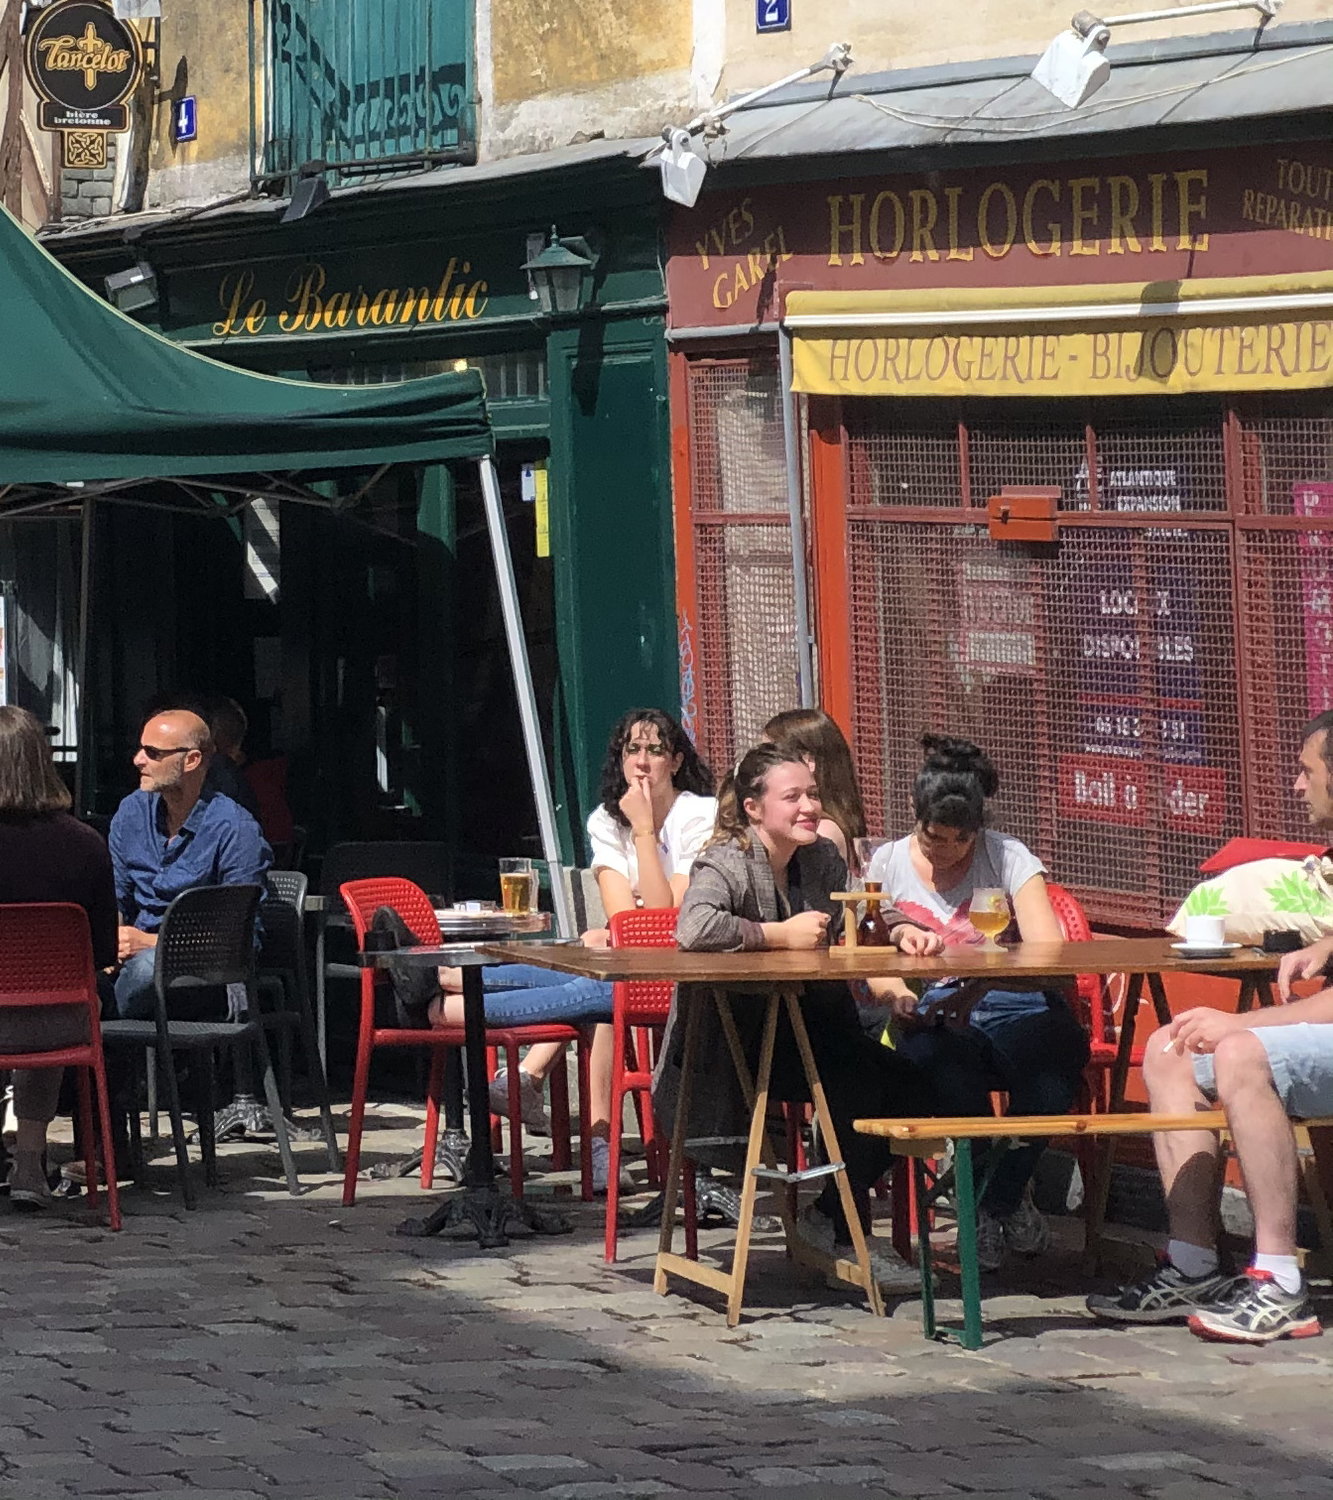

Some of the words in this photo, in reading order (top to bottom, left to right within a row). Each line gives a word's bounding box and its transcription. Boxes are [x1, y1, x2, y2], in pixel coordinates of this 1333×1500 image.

[39, 35, 131, 71] Lancelot
[54, 116, 112, 126] bretonne
[66, 110, 99, 119] bière
[177, 103, 189, 134] 4
[694, 197, 755, 271] YVES
[827, 168, 1209, 267] HORLOGERIE
[712, 226, 794, 310] GAREL
[212, 269, 267, 336] Le
[278, 256, 489, 333] Barantic
[829, 334, 1059, 383] HORLOGERIE
[1090, 322, 1333, 382] BIJOUTERIE
[1110, 469, 1177, 487] ATLANTIQUE
[1117, 494, 1182, 512] EXPANSION
